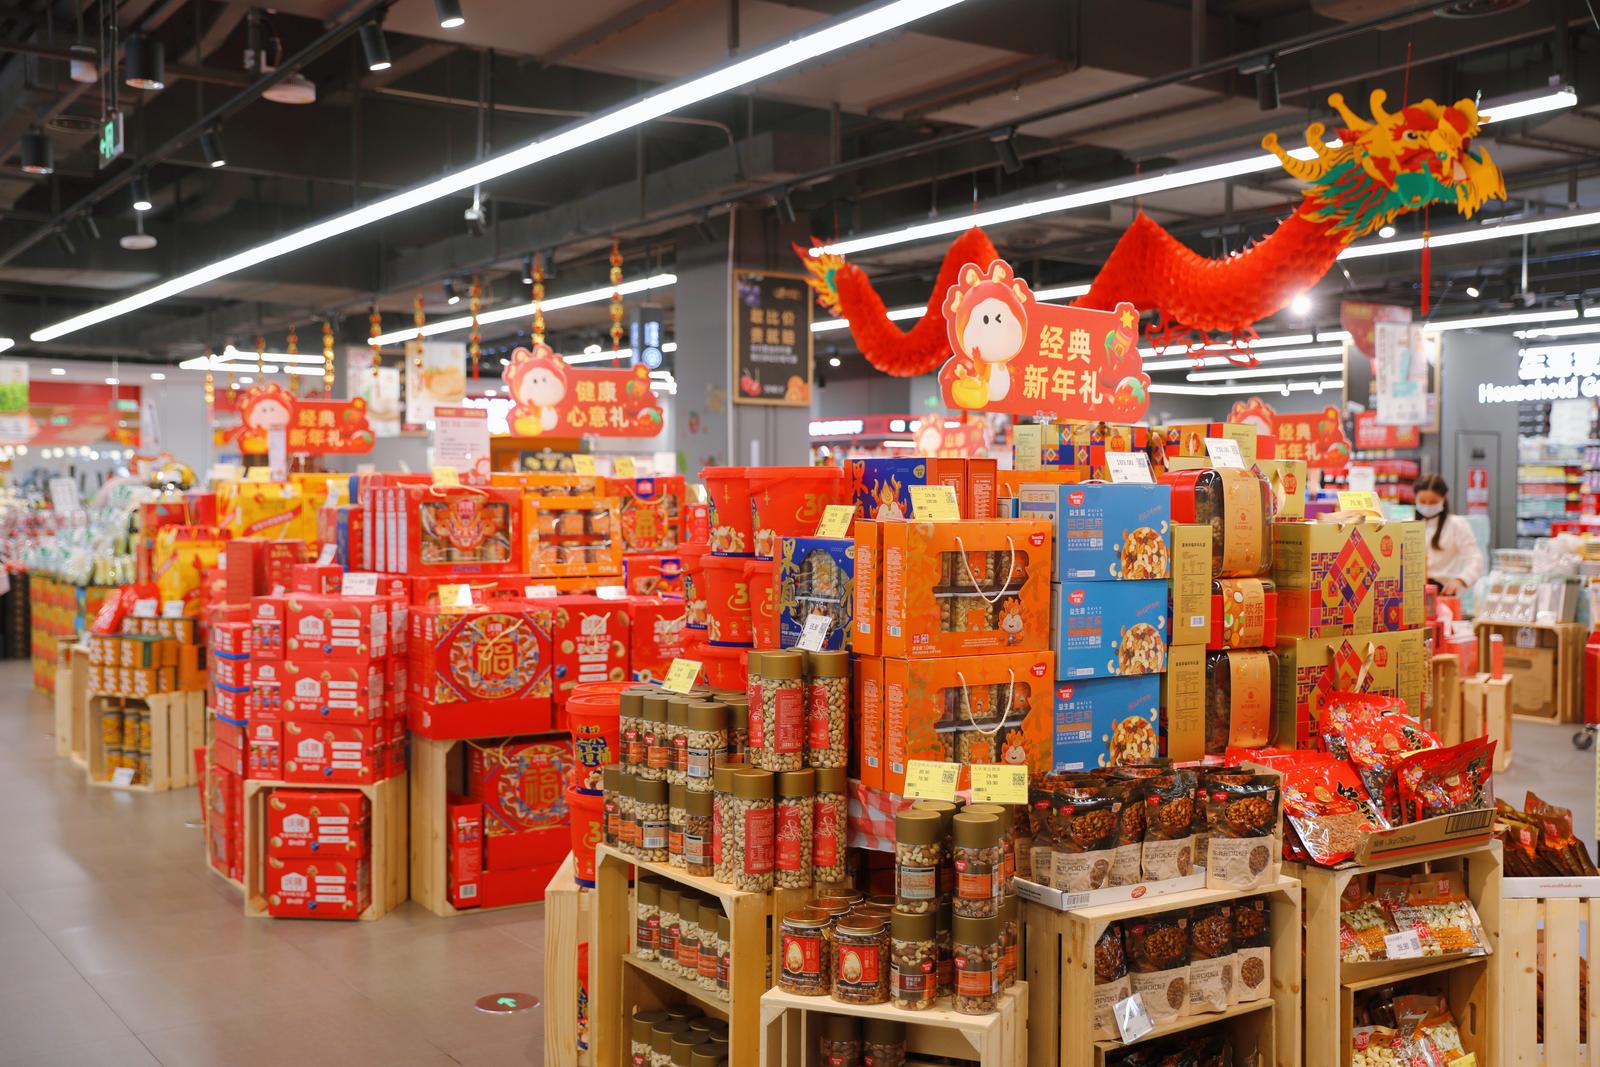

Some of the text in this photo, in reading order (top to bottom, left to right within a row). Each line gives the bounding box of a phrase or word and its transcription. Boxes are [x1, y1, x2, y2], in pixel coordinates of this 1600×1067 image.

[1039, 324, 1091, 364] 经典
[575, 380, 617, 402] 健康
[1023, 364, 1104, 404] 新年礼
[1479, 375, 1600, 404] Household G
[300, 409, 335, 427] 经典
[567, 405, 629, 428] 心意礼
[289, 428, 345, 447] 新年礼
[1278, 422, 1312, 441] 经典
[477, 637, 514, 676] 福
[524, 767, 559, 806] 福
